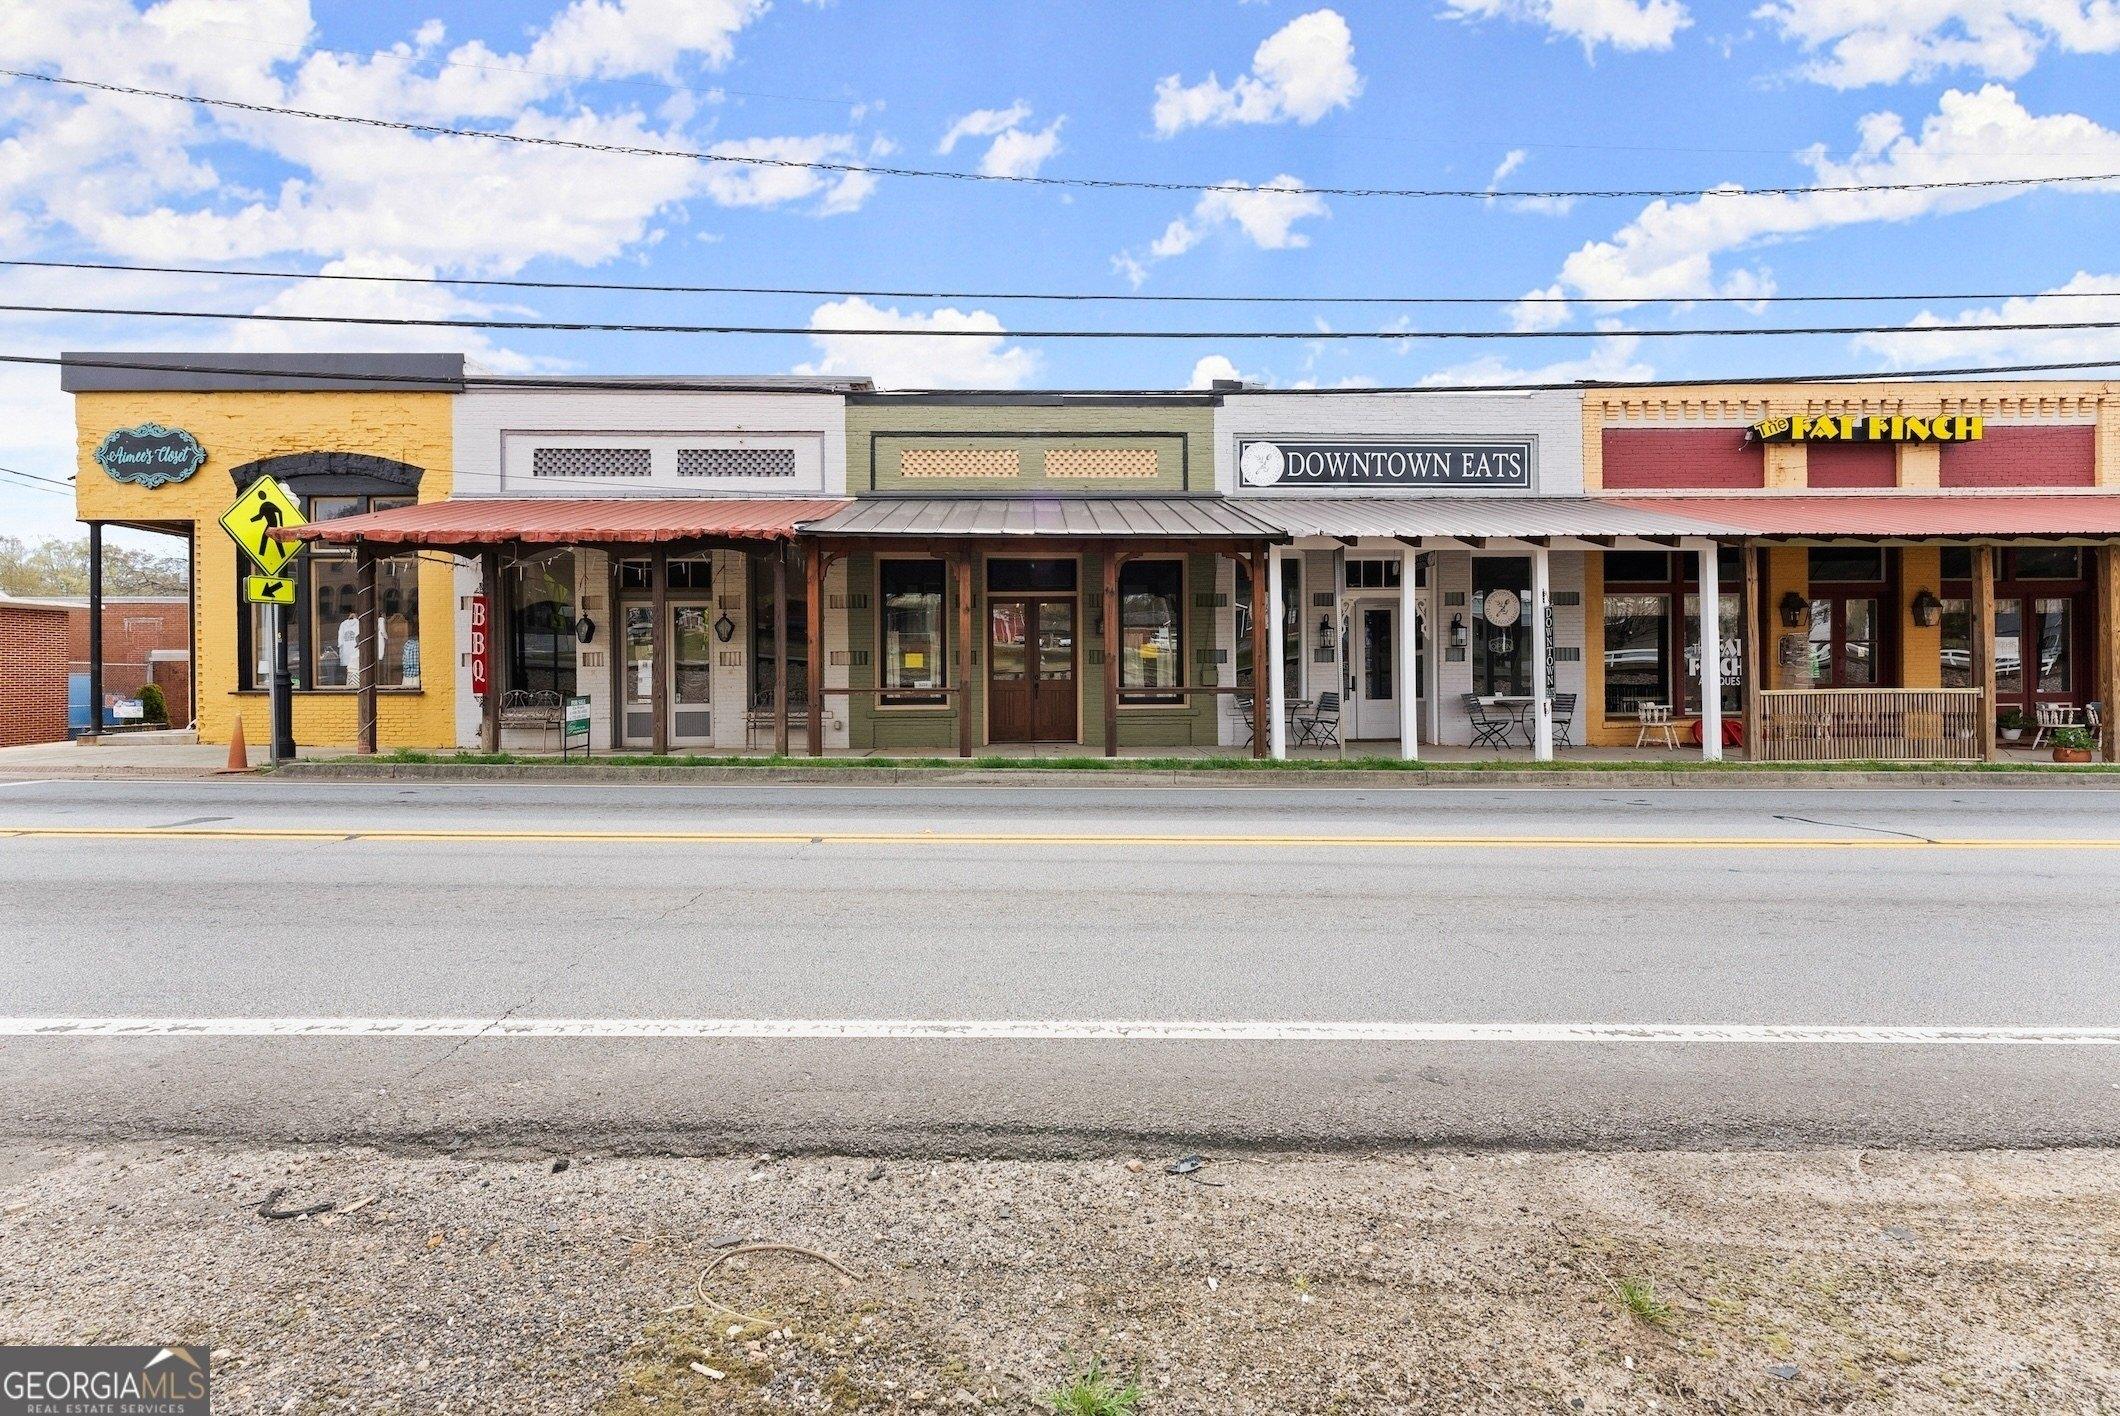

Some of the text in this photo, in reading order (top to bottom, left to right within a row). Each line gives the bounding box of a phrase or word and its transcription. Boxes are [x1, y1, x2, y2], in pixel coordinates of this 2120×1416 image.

[1754, 413, 1984, 441] The FAT FINCH
[107, 446, 191, 464] Aimee's Closet
[1287, 451, 1452, 478] DOWNTOWN
[1461, 451, 1522, 478] EATS
[472, 602, 486, 683] BBQ
[1545, 608, 1554, 686] DOWNTOWN
[1689, 657, 1742, 676] FCH
